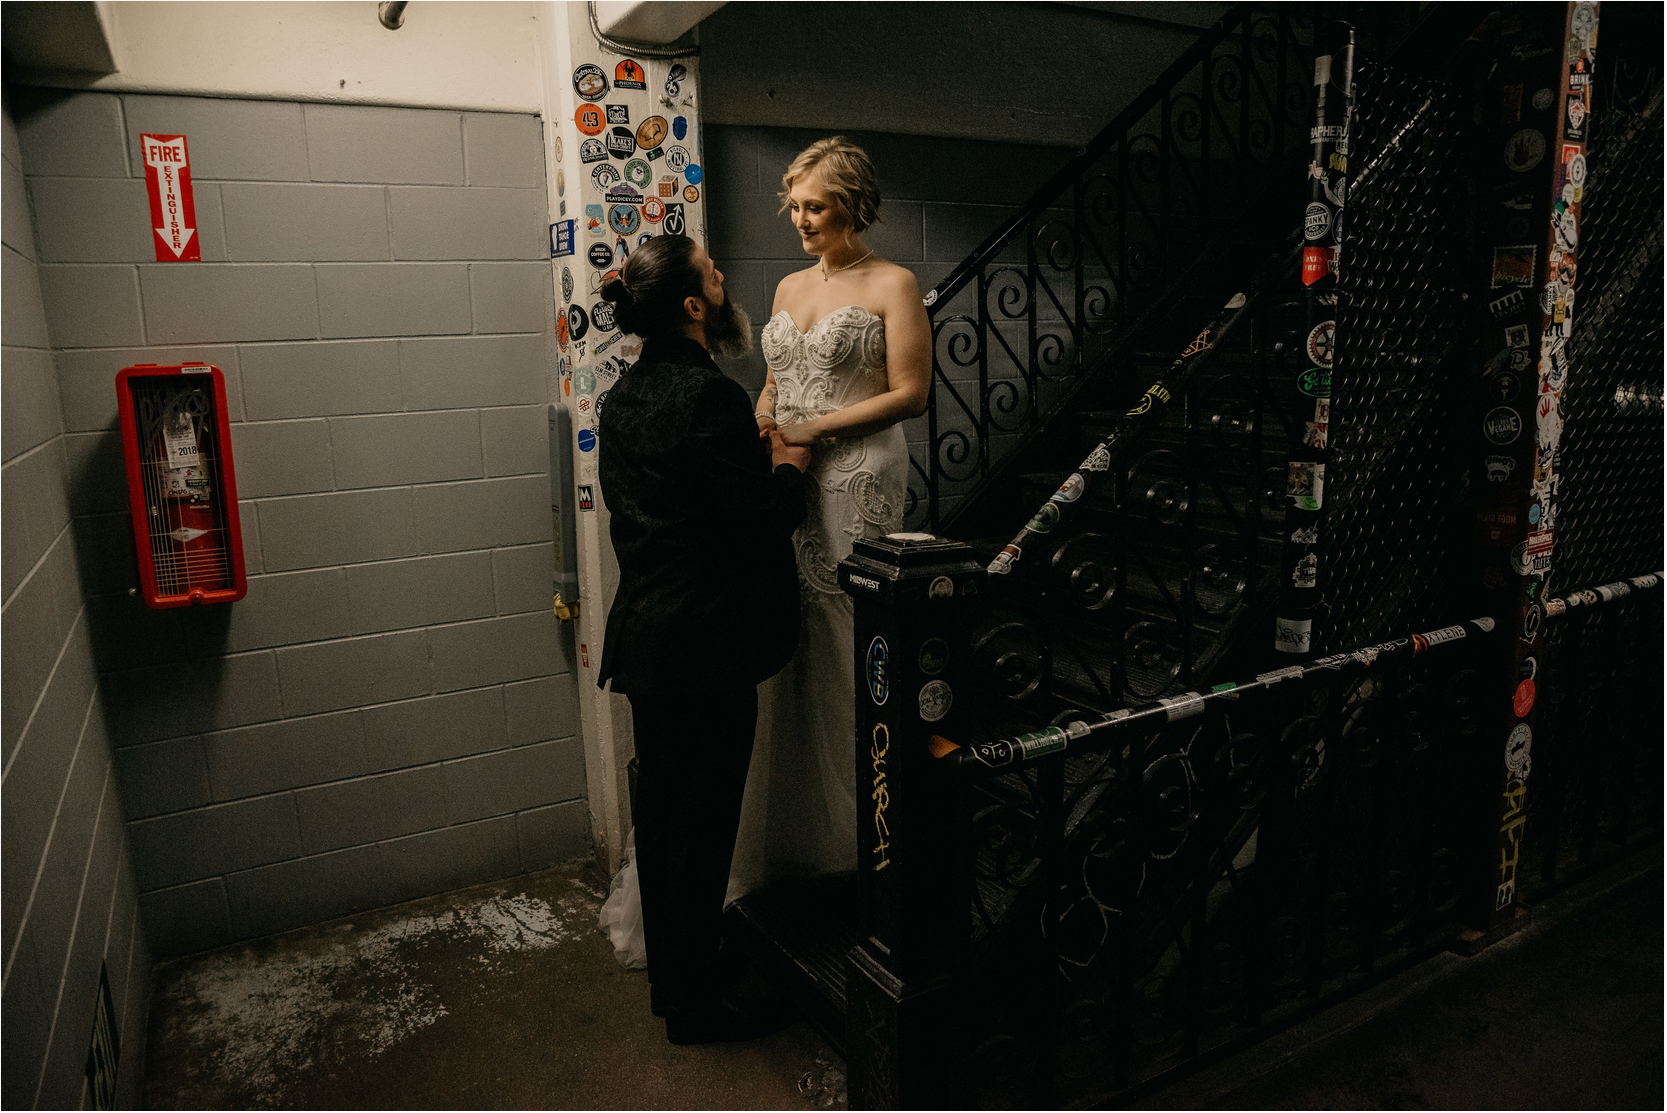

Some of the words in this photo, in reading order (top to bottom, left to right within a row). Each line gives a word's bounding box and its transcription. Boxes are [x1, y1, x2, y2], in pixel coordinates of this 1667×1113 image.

[582, 111, 599, 127] 43
[150, 145, 182, 162] FIRE
[164, 166, 181, 249] EXTINGUISHER
[178, 446, 197, 456] 2018
[1486, 456, 1515, 468] DIMO'S
[1476, 512, 1496, 522] PLAID
[1496, 514, 1517, 524] ROOM
[849, 573, 880, 590] MIDWEST
[1428, 626, 1465, 644] XYLENE
[873, 642, 886, 699] CWB
